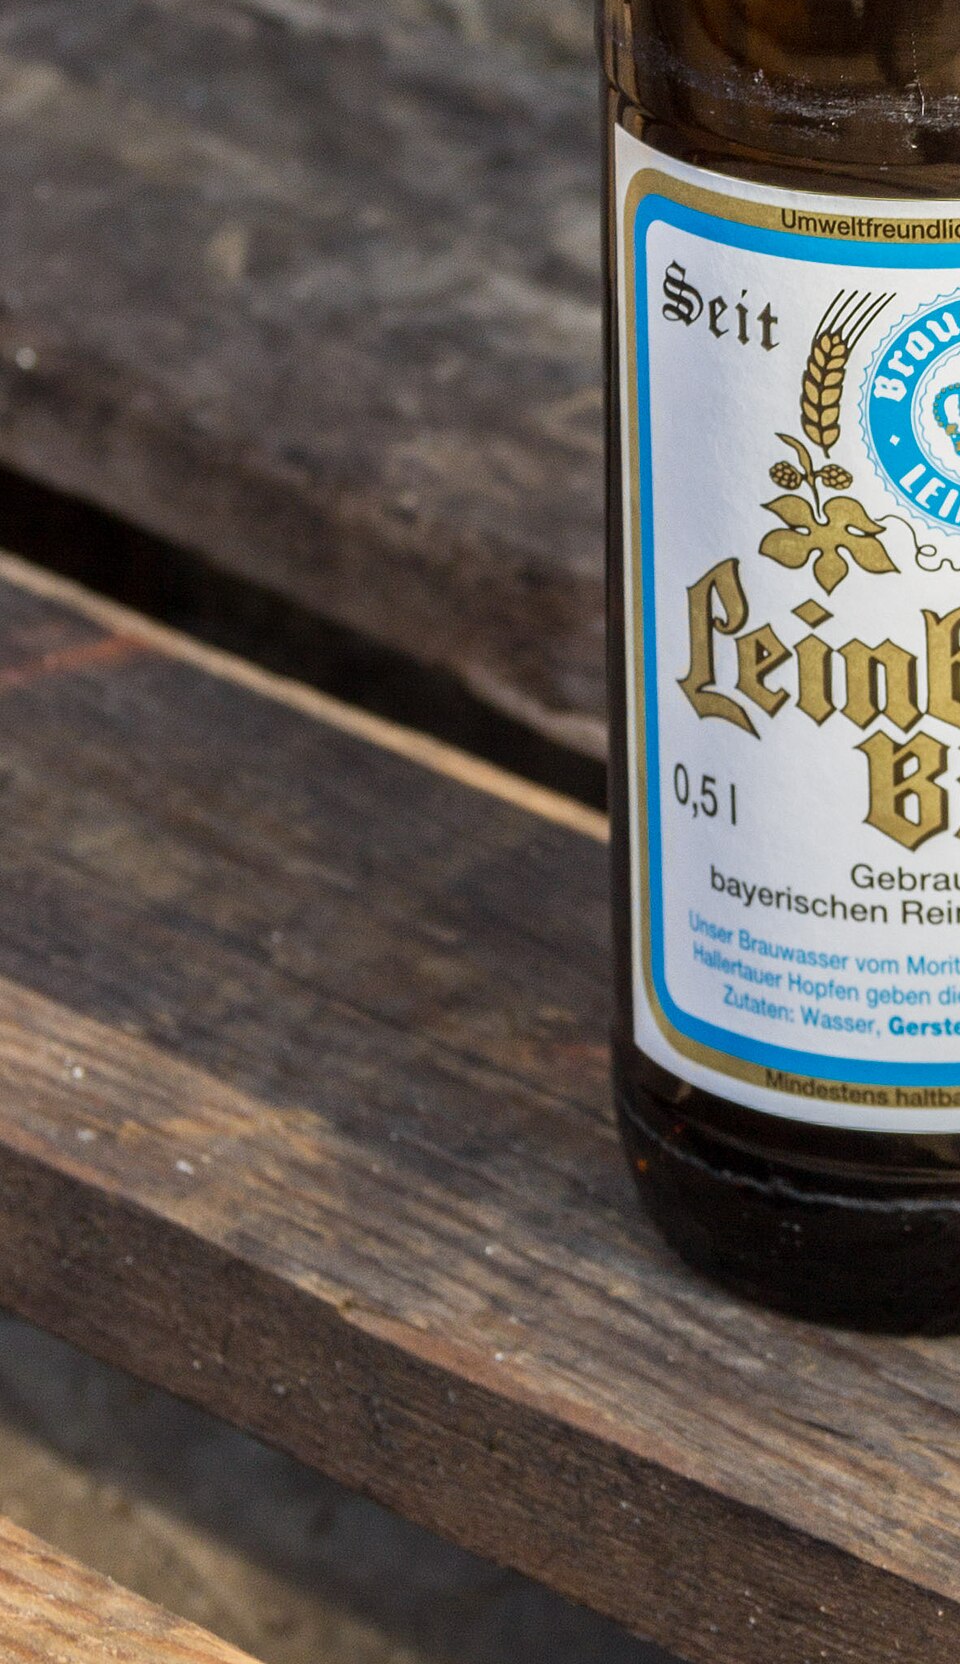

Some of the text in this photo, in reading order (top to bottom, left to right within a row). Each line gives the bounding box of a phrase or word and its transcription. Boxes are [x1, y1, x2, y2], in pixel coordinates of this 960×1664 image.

[661, 261, 780, 352] Seit
[674, 763, 719, 818] 0,5
[709, 865, 889, 926] bayerischen
[689, 910, 734, 945] Unser
[738, 929, 849, 972] Brauwasser
[855, 954, 899, 974] vom
[692, 943, 782, 989] Hallertauer
[788, 971, 859, 1003] Hopfen
[866, 984, 931, 1009] geben
[723, 984, 795, 1023] Zutaten:
[800, 1006, 881, 1038] Wasser,
[764, 1068, 888, 1107] Mindestens
